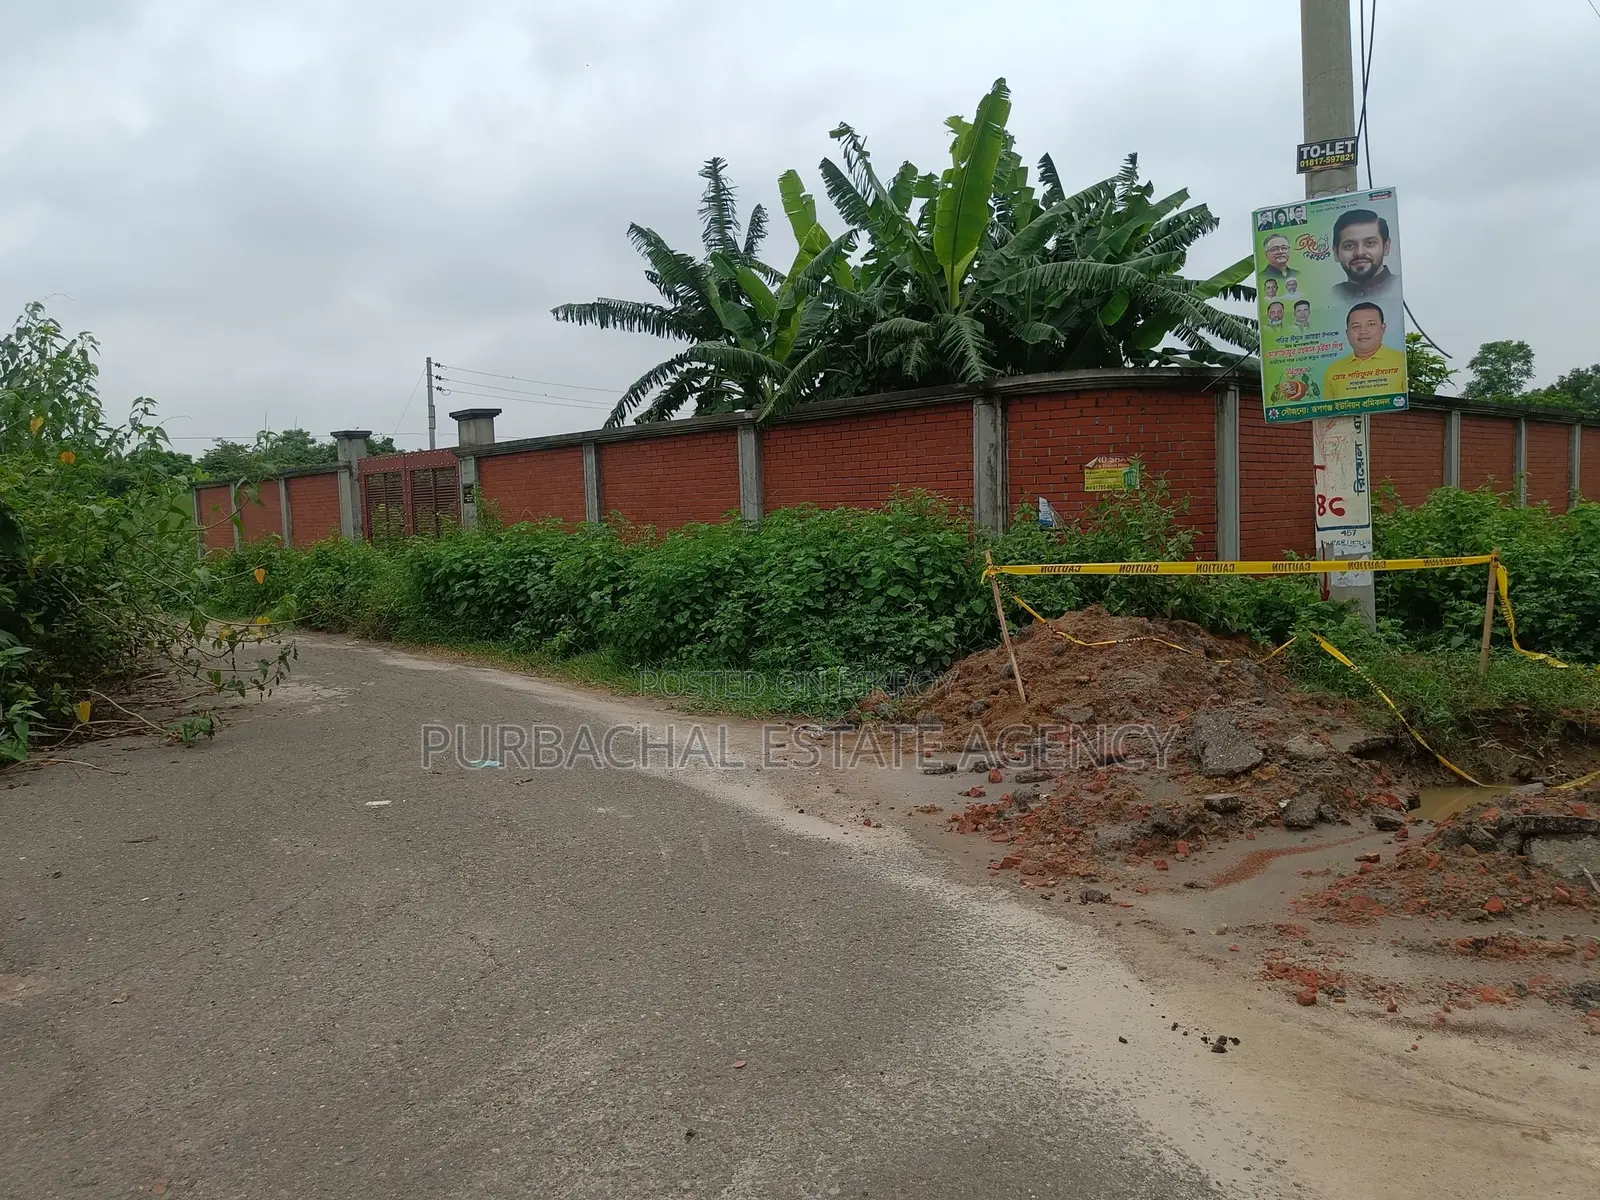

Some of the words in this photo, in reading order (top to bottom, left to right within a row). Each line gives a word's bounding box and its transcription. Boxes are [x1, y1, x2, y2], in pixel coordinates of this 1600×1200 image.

[1300, 140, 1355, 160] TO-LET
[1300, 153, 1354, 168] 01817-597821
[1376, 368, 1400, 376] ইসলাম
[1335, 400, 1360, 410] ইউনিয়ন
